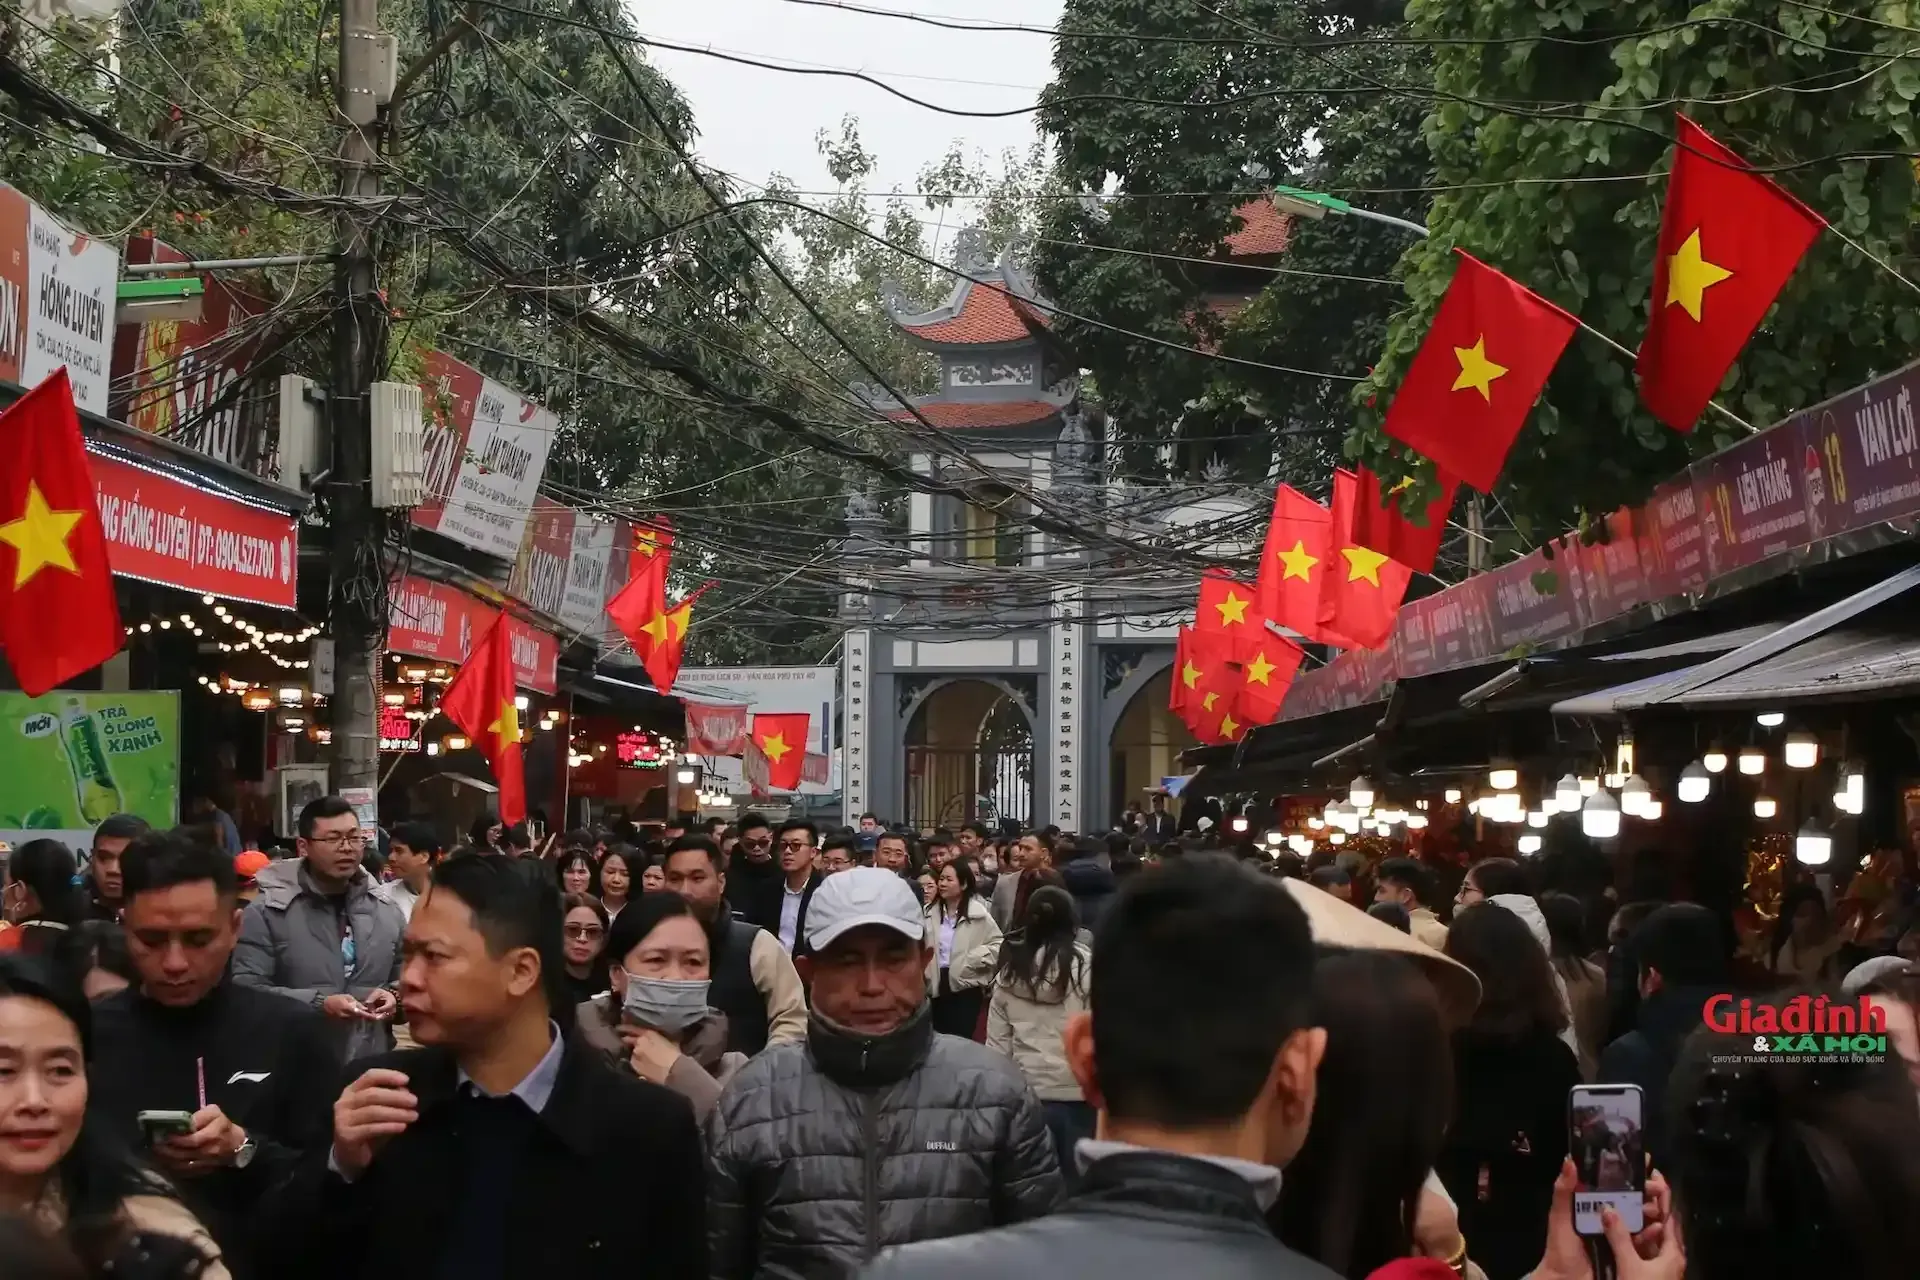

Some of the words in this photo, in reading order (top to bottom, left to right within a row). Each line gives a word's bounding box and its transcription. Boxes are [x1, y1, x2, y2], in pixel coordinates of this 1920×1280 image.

[1887, 384, 1918, 469] LỢI
[155, 505, 191, 561] LUYẾN
[215, 529, 275, 580] 0904.527.700
[98, 704, 127, 719] TRÀ
[25, 716, 52, 735] MỚI
[104, 722, 114, 735] Ô
[117, 716, 155, 733] LONG
[108, 729, 162, 752] XANH
